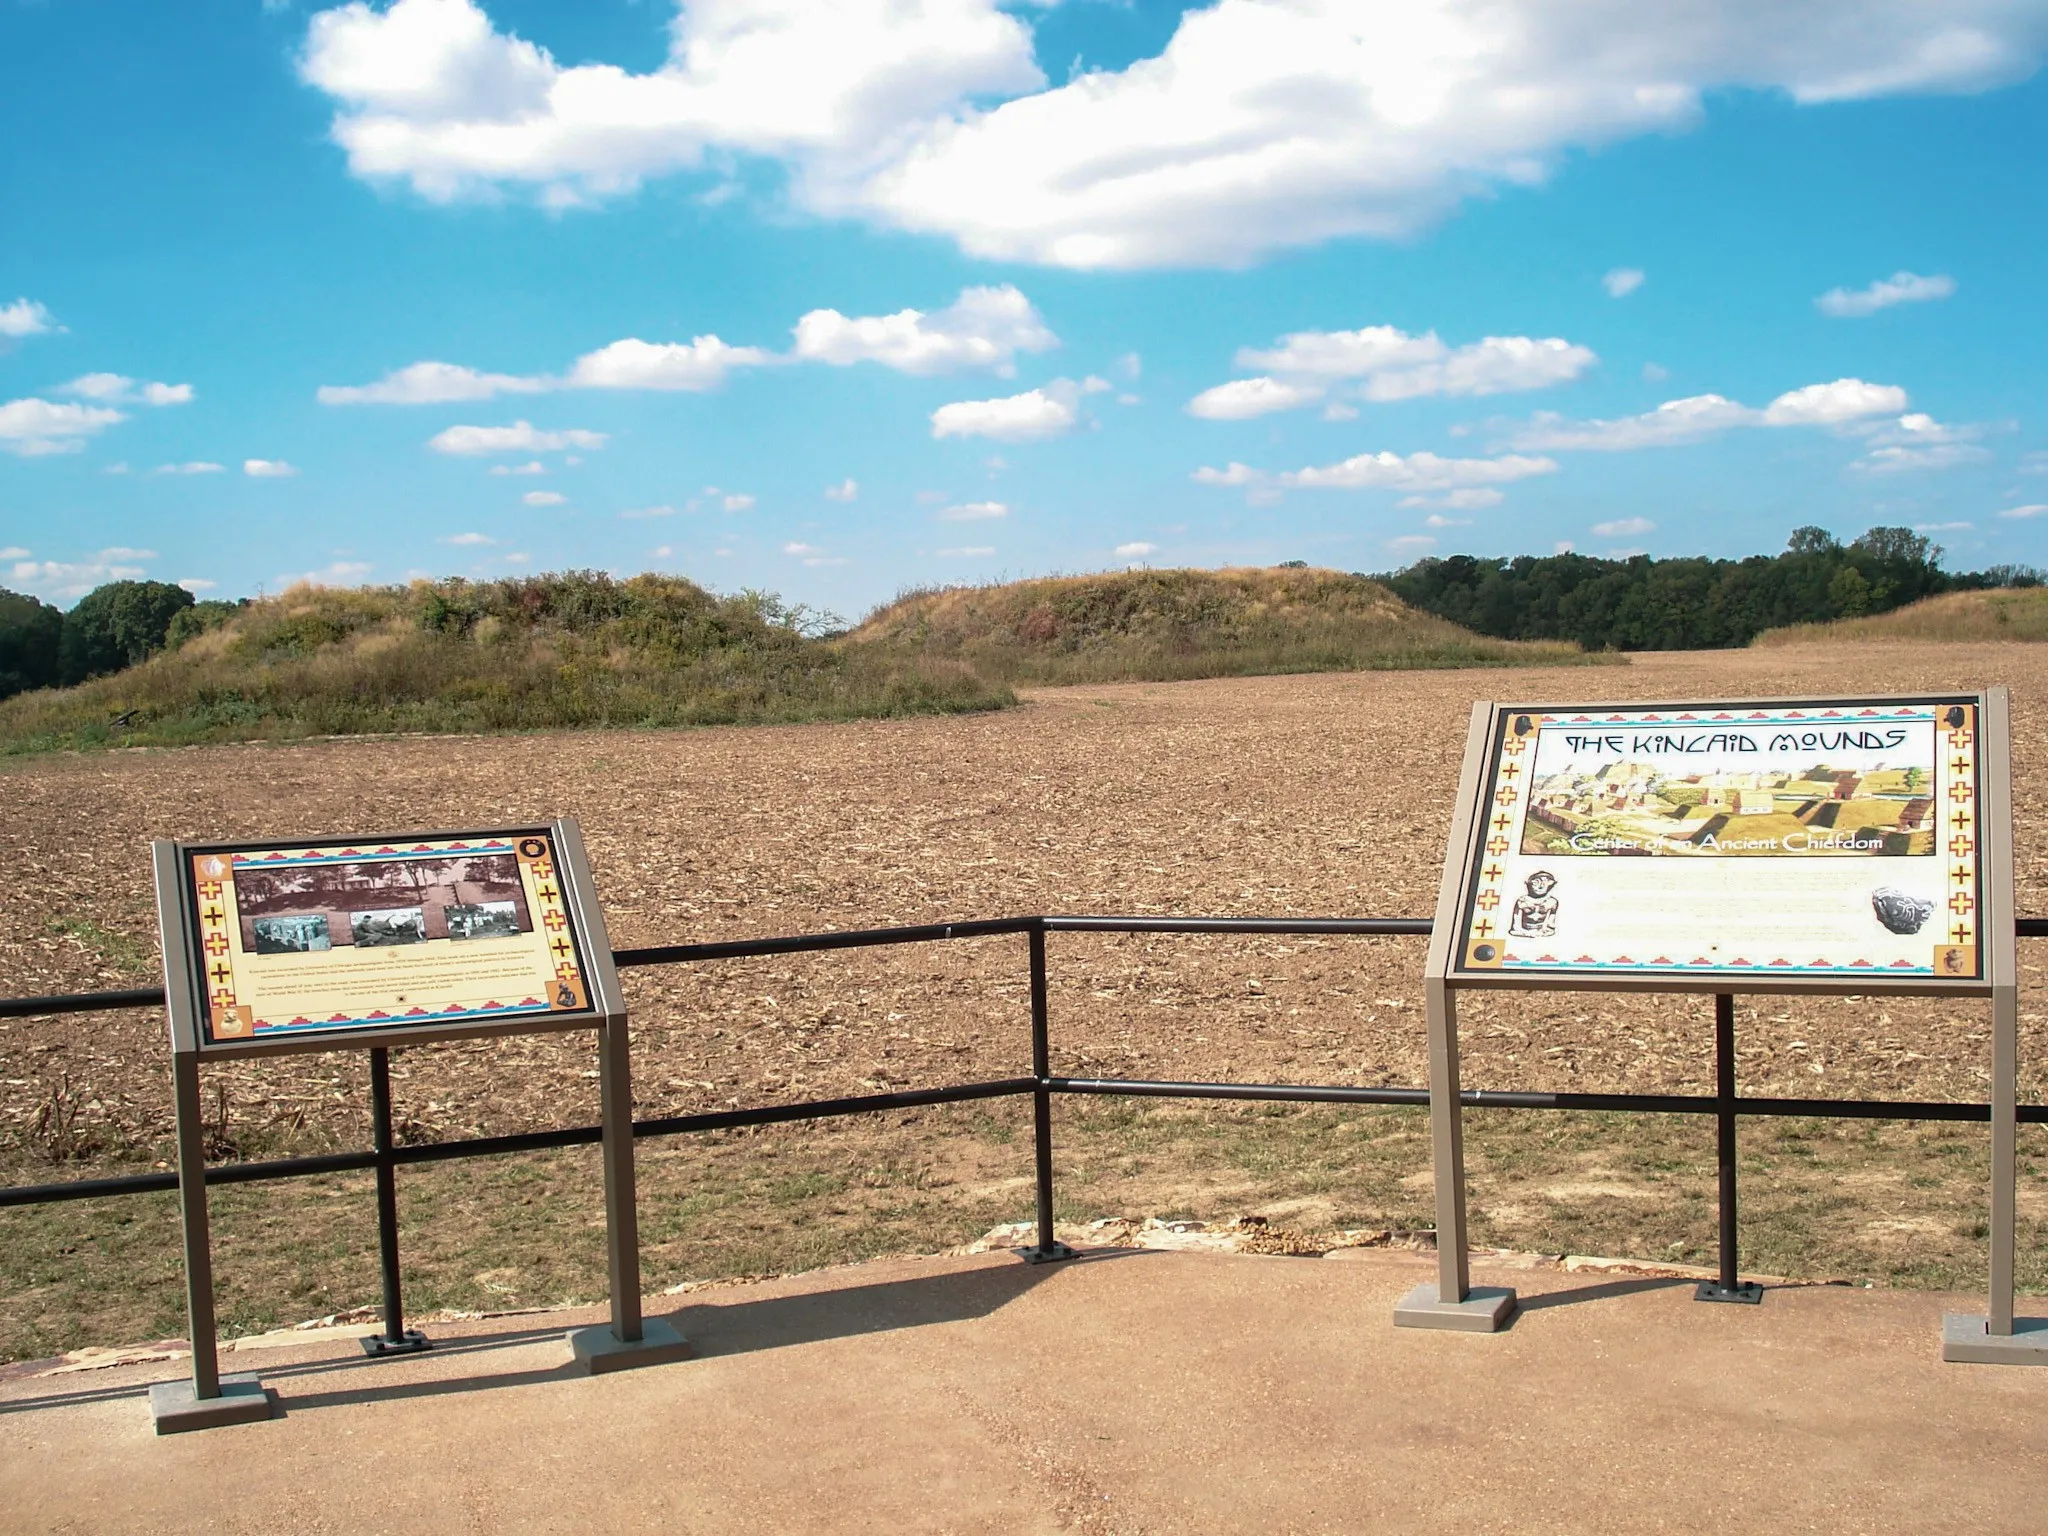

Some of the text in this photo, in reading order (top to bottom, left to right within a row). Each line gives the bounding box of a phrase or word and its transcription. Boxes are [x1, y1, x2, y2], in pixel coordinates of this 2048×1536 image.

[1565, 735, 1624, 753] THE
[1769, 730, 1907, 751] MOUNDS
[1570, 832, 1639, 852] Center
[1645, 833, 1668, 851] of
[1697, 832, 1777, 852] Ancient
[1782, 832, 1883, 852] Chiefdom
